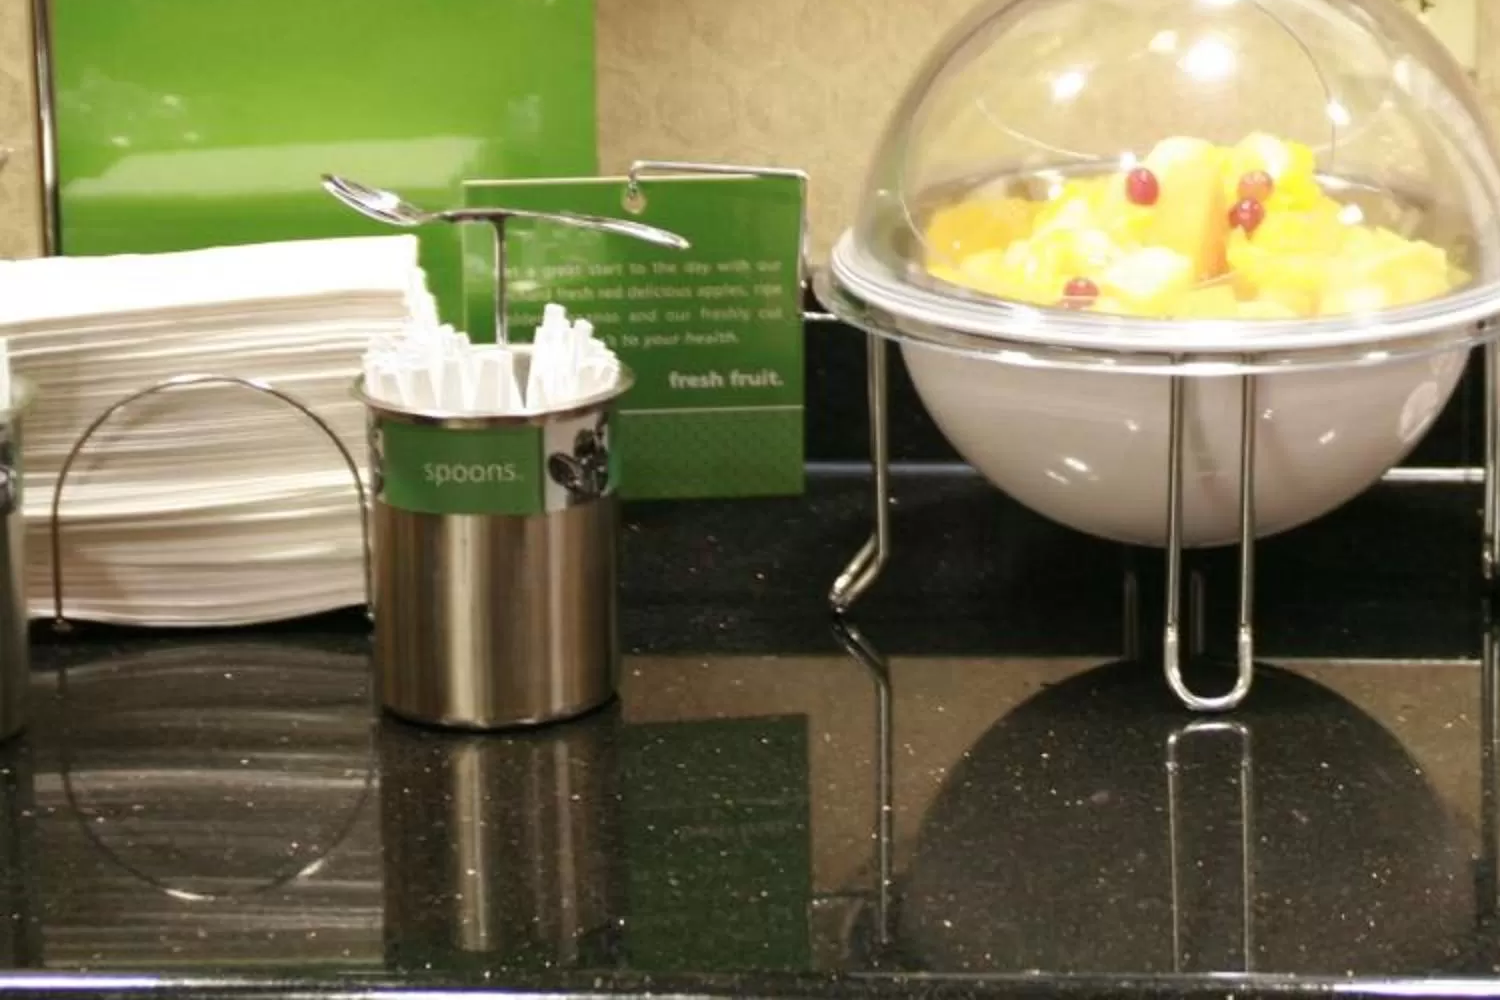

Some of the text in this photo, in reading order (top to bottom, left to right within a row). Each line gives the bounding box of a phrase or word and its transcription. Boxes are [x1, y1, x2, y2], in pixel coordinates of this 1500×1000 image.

[587, 263, 624, 276] start
[630, 263, 647, 275] to
[653, 262, 677, 274] the
[683, 261, 712, 276] day
[716, 259, 751, 273] with
[756, 260, 783, 272] our
[557, 286, 594, 299] fresh
[598, 286, 624, 299] red
[628, 284, 693, 298] delicious
[630, 310, 657, 323] and
[664, 311, 691, 322] our
[701, 307, 750, 321] freshly
[623, 334, 639, 346] to
[643, 335, 680, 348] your
[685, 331, 739, 345] health.
[668, 368, 785, 389] fresh fruit.
